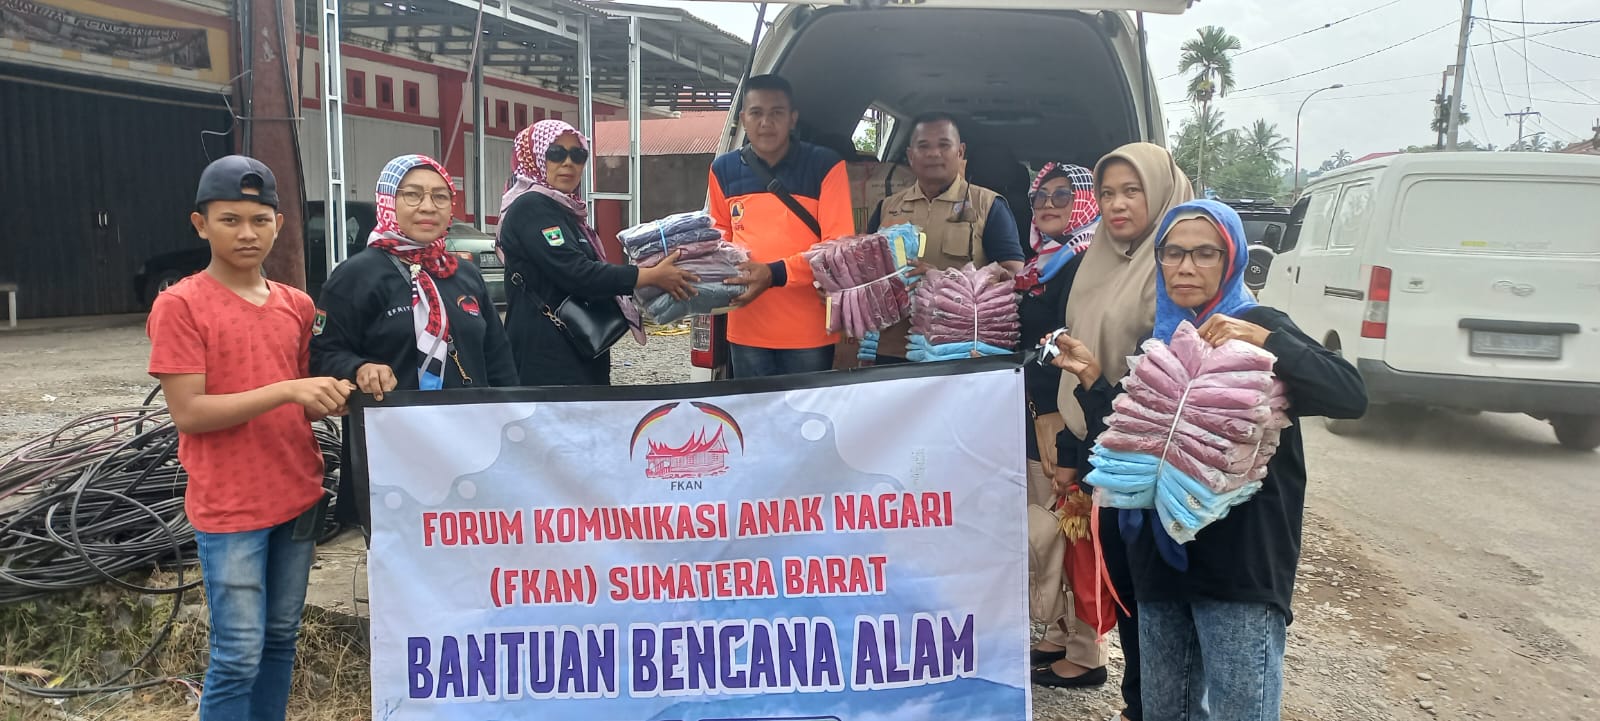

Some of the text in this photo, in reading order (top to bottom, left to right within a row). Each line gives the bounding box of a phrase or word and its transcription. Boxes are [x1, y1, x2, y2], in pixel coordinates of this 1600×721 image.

[670, 480, 703, 491] FKAN
[423, 490, 954, 547] FORUM KOMUNIKASI ANAK NAGARI
[490, 556, 887, 606] (FKAN) SUMATERA BARAT
[407, 614, 976, 700] BANTUAN BENCANA ALAM
